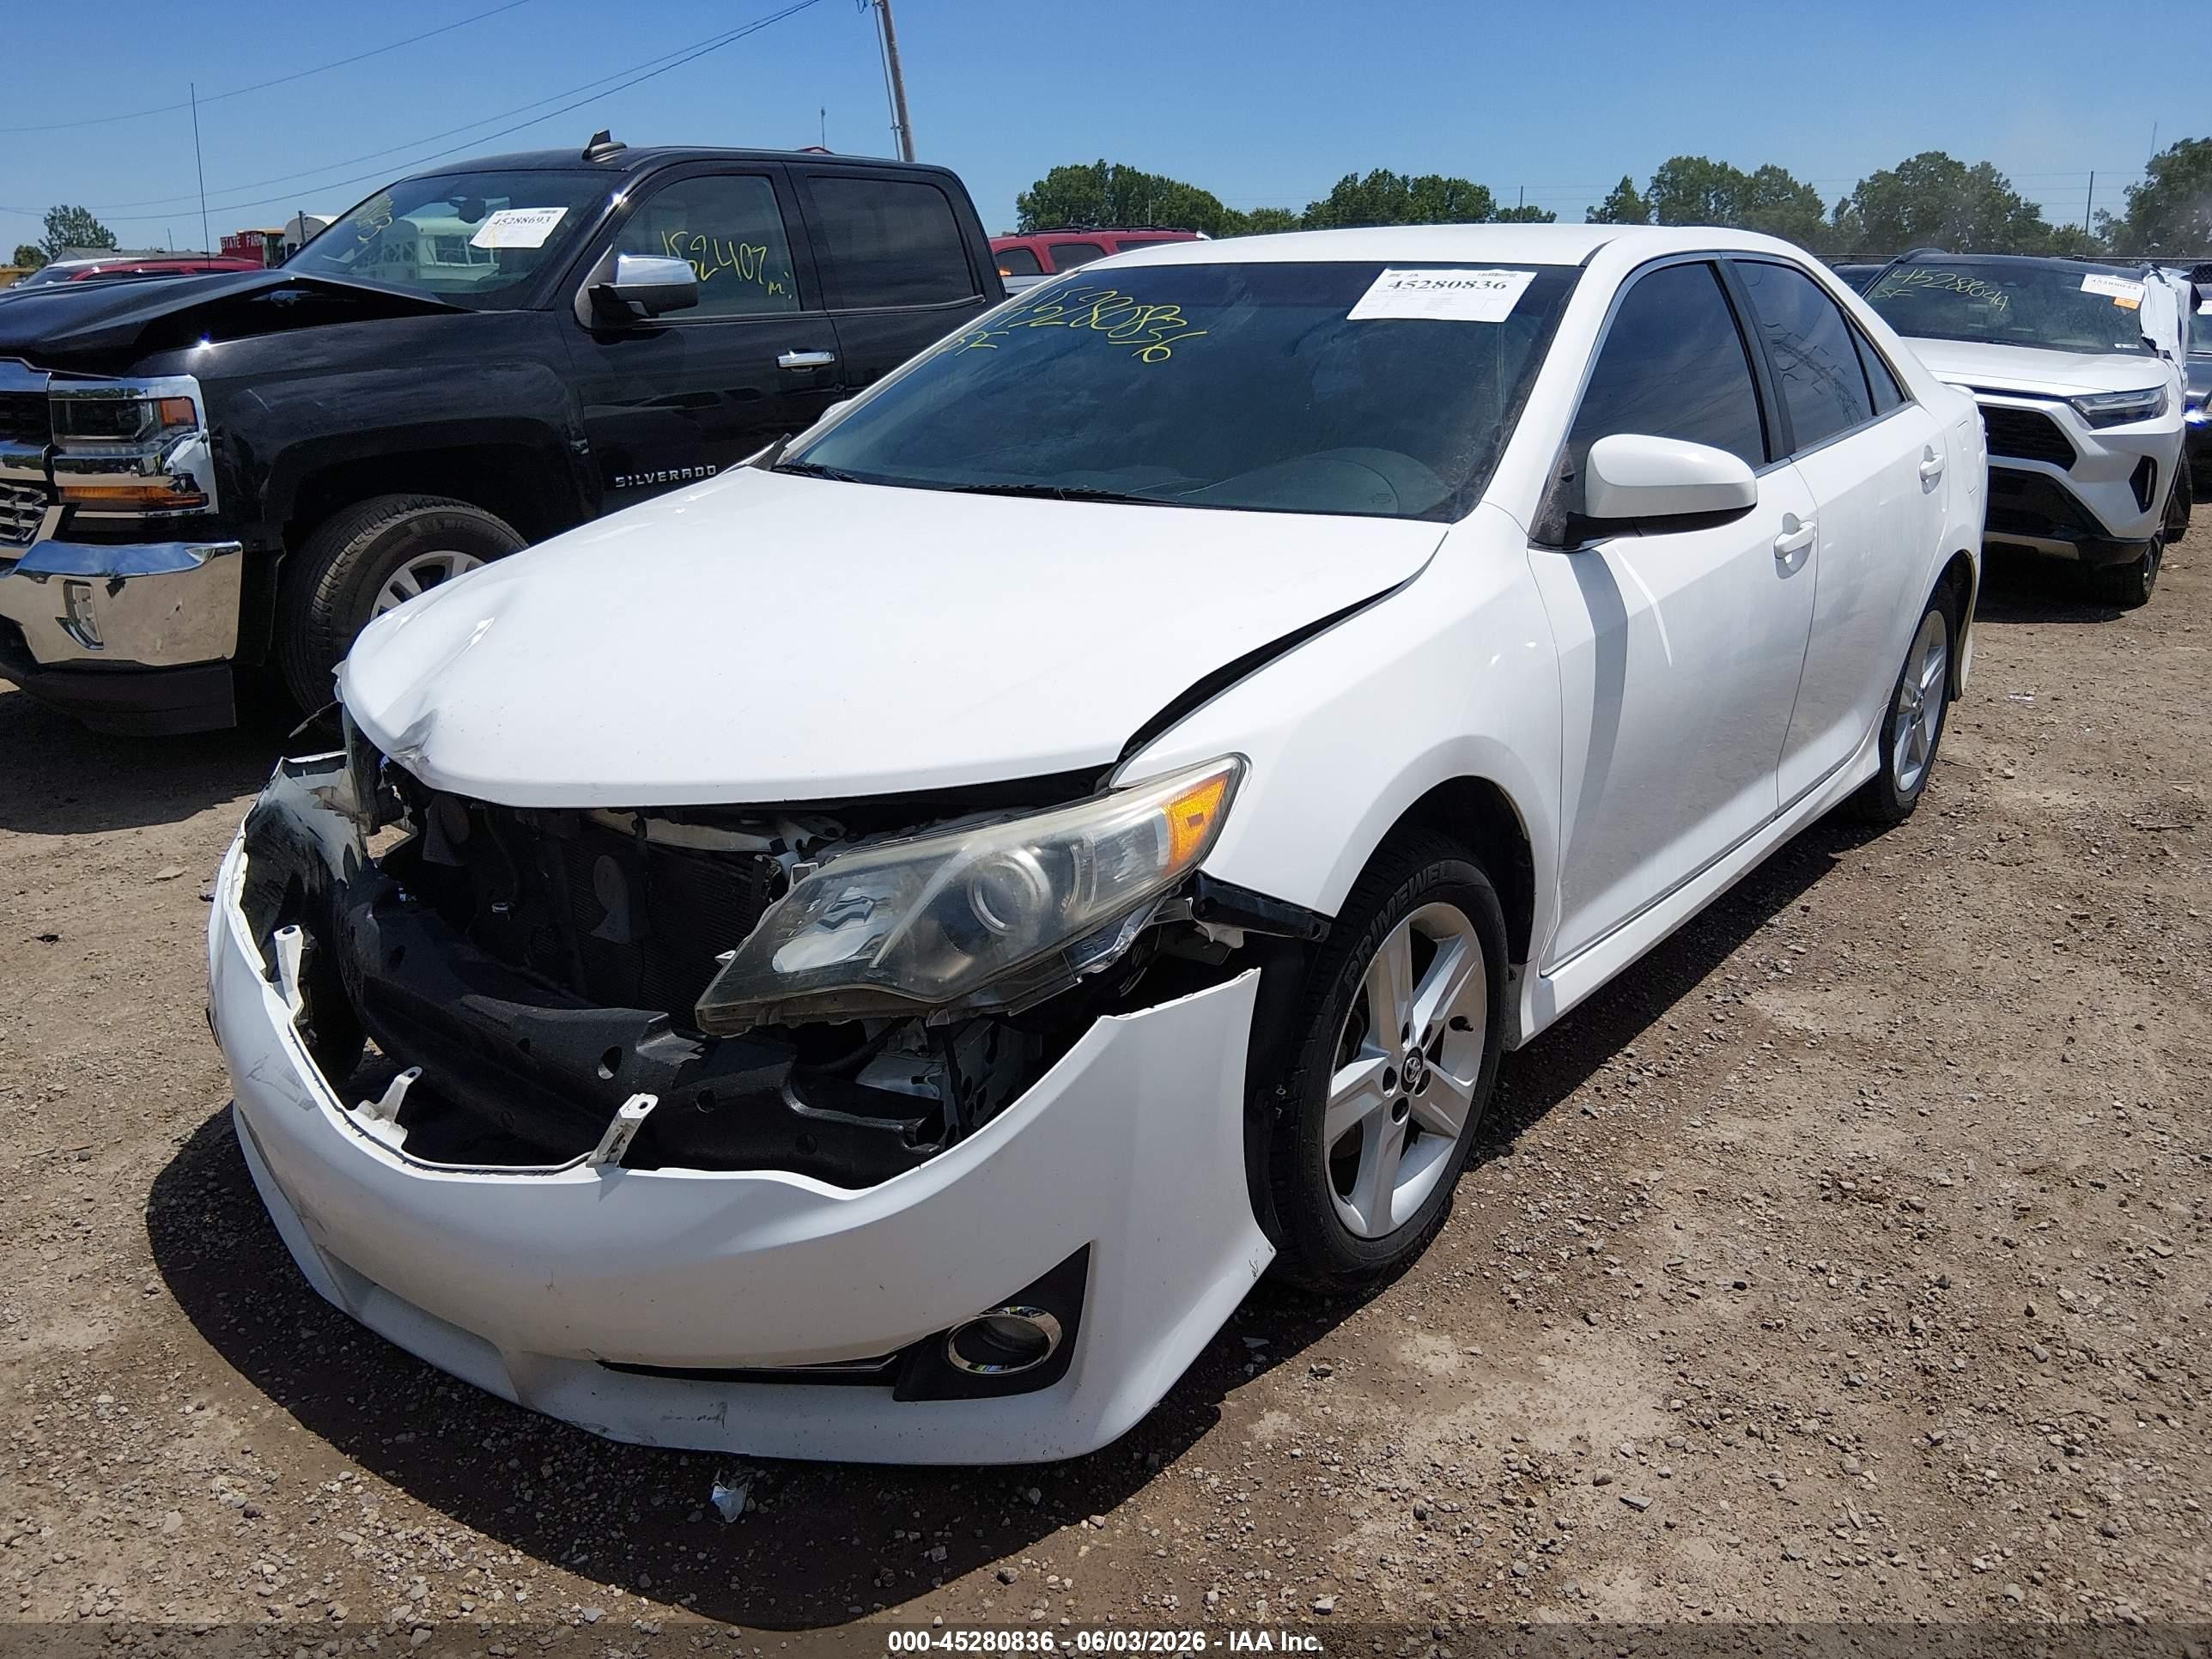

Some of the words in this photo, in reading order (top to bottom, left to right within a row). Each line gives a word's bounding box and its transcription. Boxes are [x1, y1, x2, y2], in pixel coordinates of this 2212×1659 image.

[493, 216, 551, 226] 45288693
[1388, 280, 1507, 289] 45280836
[615, 465, 716, 488] SILVERADO
